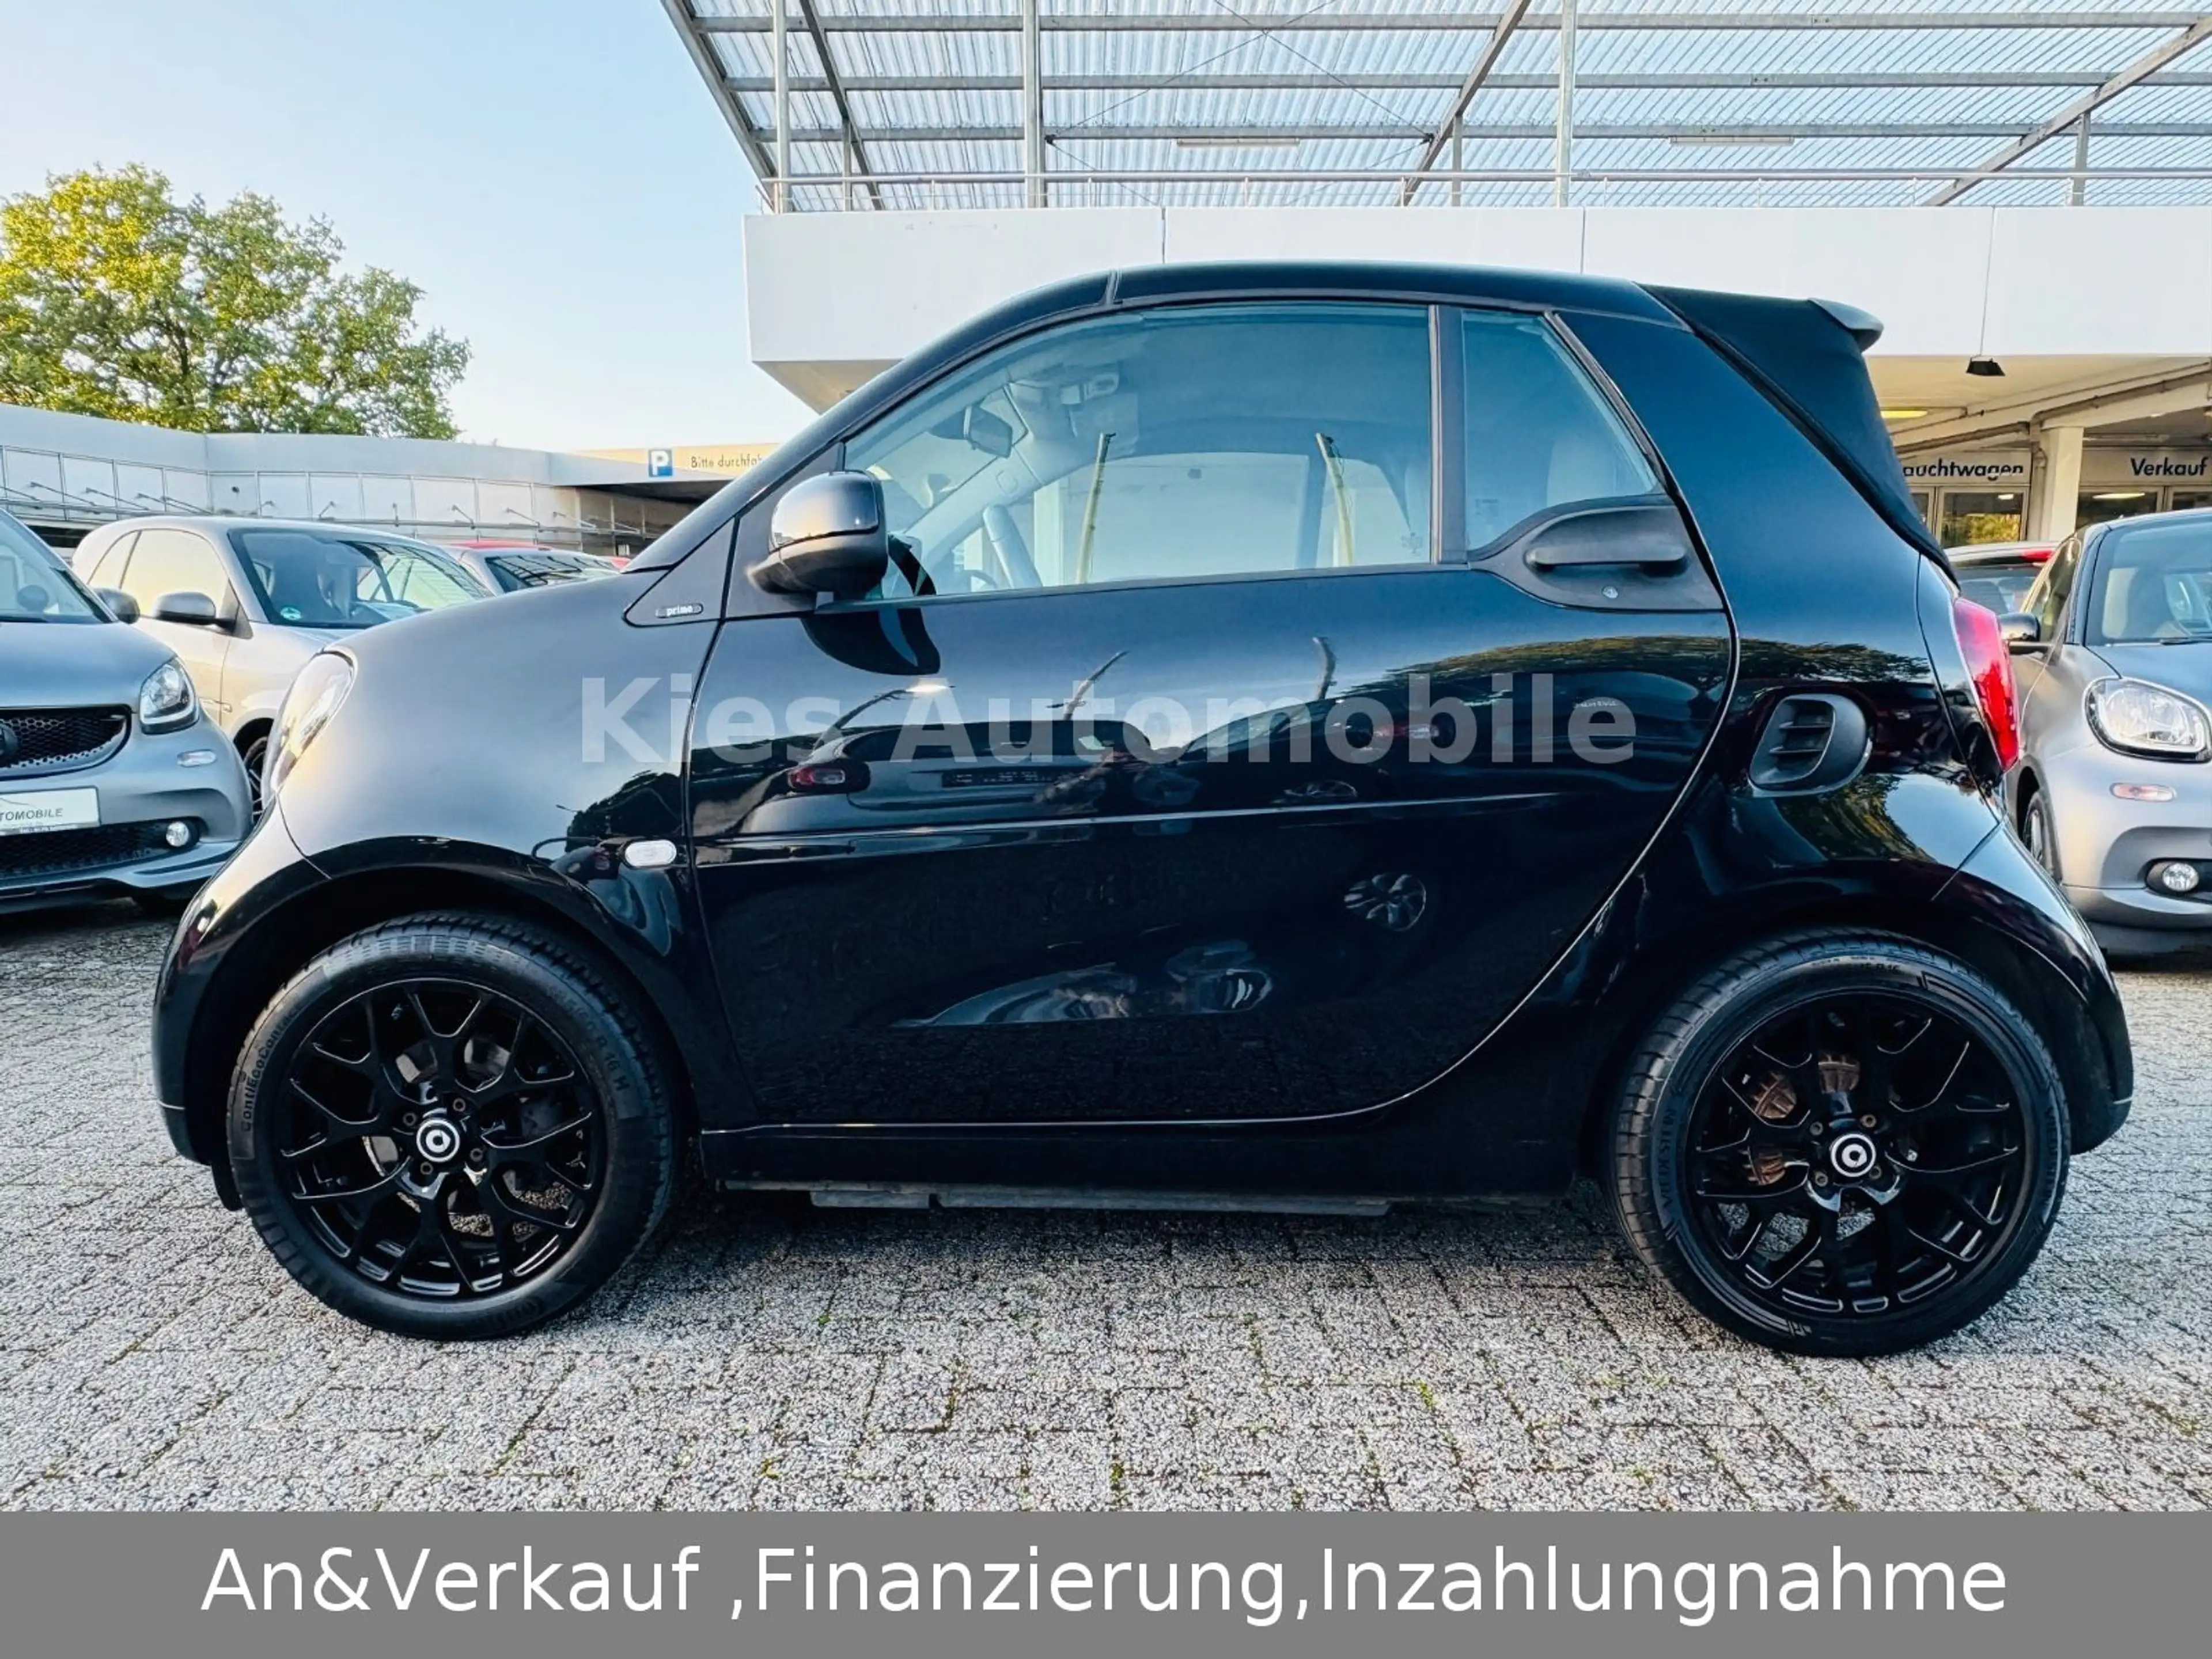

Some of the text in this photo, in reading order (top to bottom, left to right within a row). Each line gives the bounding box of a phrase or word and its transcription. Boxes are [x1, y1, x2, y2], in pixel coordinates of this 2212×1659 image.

[651, 451, 669, 476] P
[691, 455, 714, 468] Bitte
[1903, 458, 2023, 480] auchtwagen
[2130, 456, 2209, 475] Verkauf
[666, 605, 693, 616] prime
